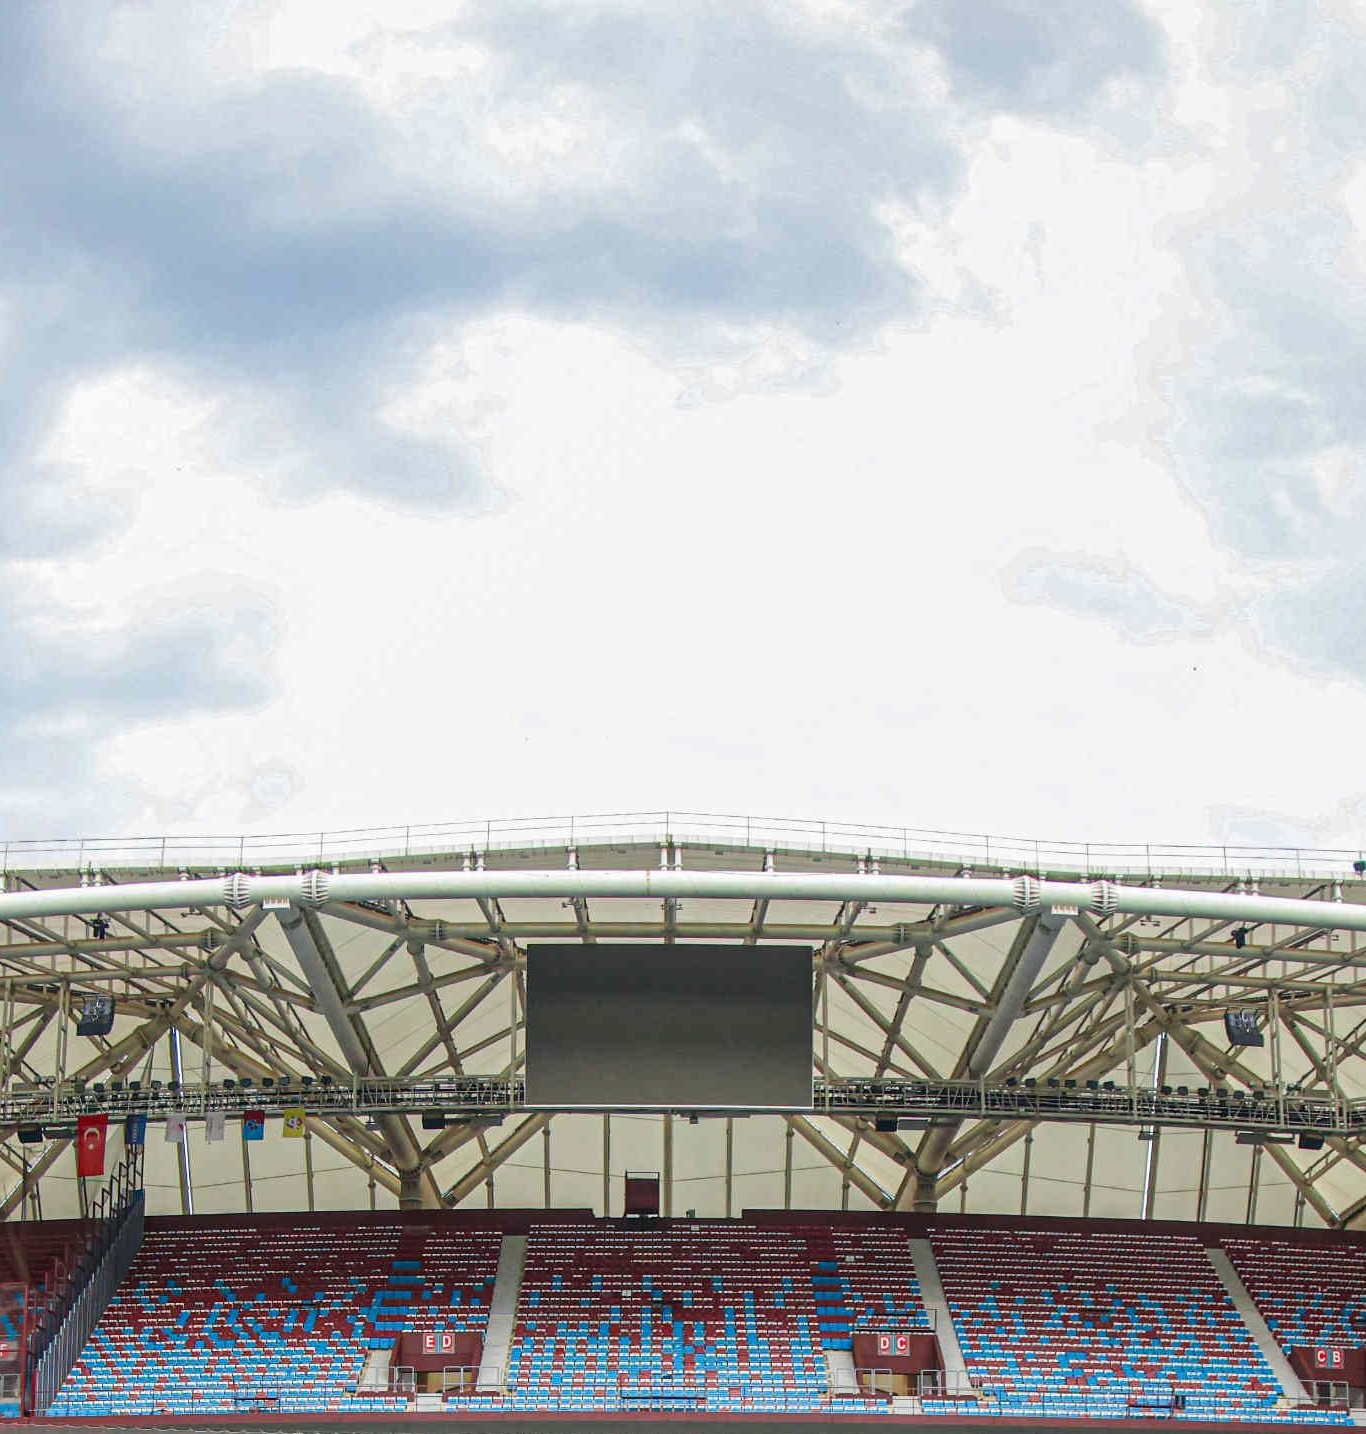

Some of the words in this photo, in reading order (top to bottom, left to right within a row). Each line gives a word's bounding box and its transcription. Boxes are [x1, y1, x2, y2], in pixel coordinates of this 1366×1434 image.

[426, 1335, 435, 1348] E
[443, 1335, 452, 1348] D
[881, 1337, 889, 1349] D
[897, 1337, 906, 1350] C
[1317, 1350, 1325, 1362] C
[1333, 1351, 1340, 1363] B
